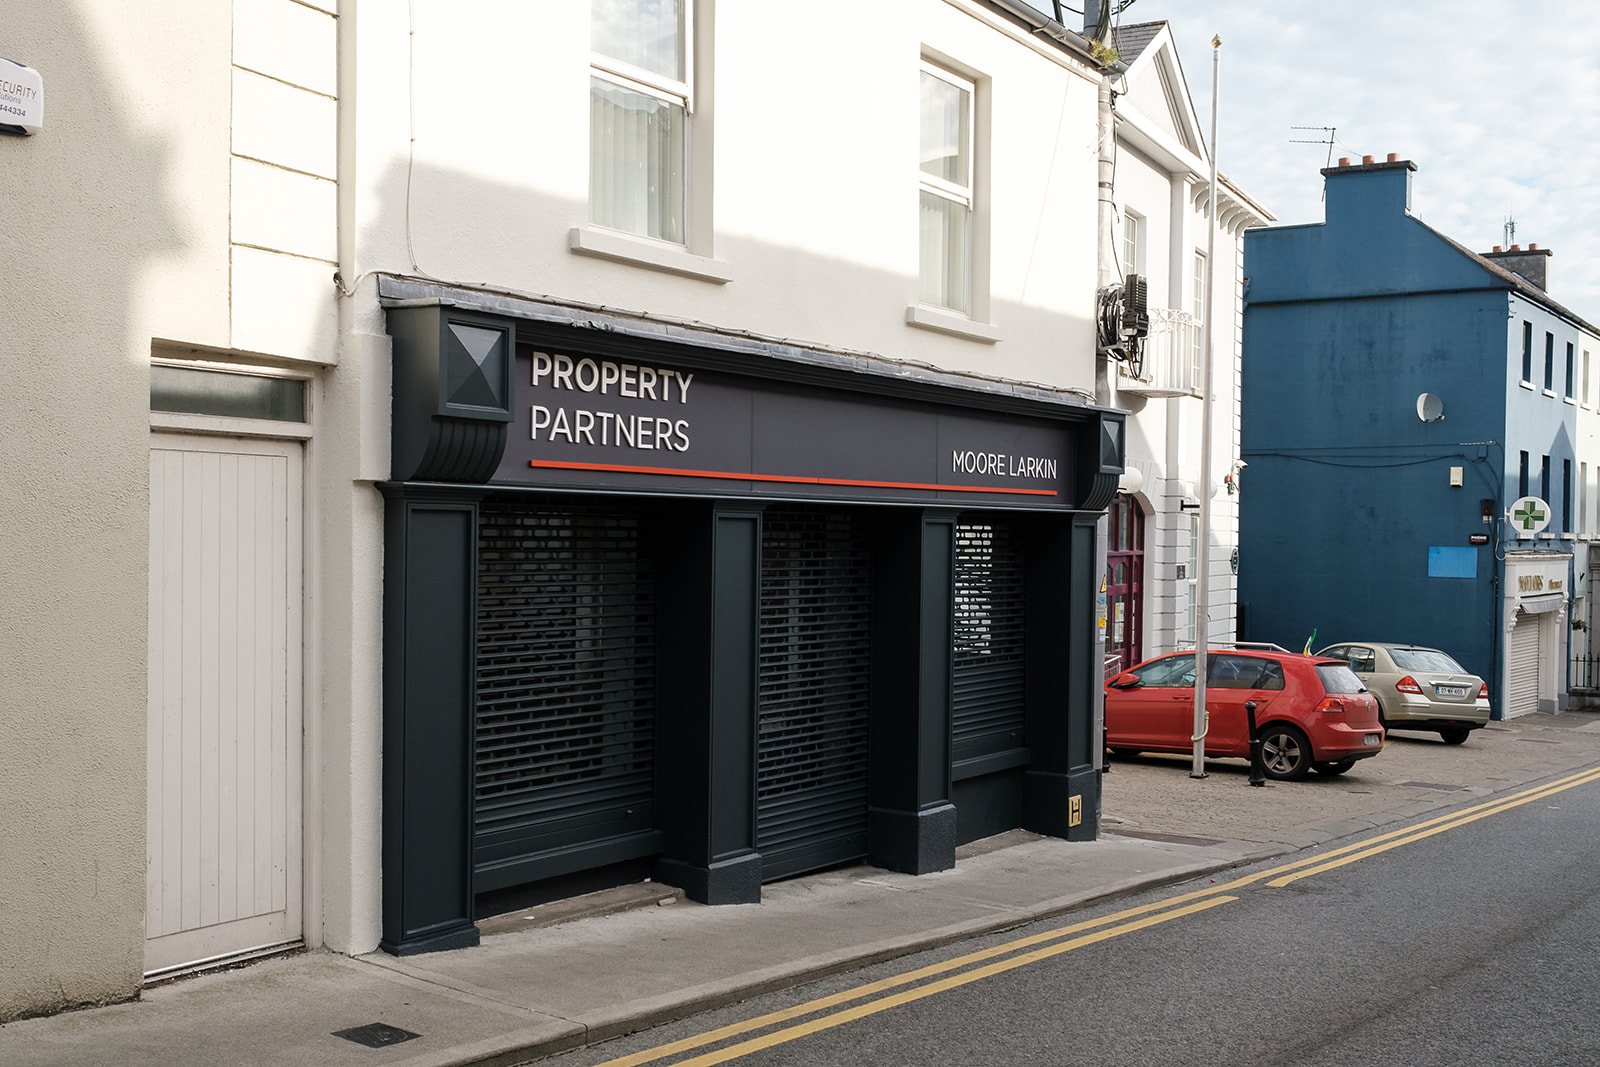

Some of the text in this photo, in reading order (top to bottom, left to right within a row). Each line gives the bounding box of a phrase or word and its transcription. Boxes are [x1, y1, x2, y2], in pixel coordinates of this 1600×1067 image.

[531, 351, 694, 404] PROPERTY
[530, 405, 690, 452] PARTNERS
[952, 450, 1057, 479] MOORE LARKIN
